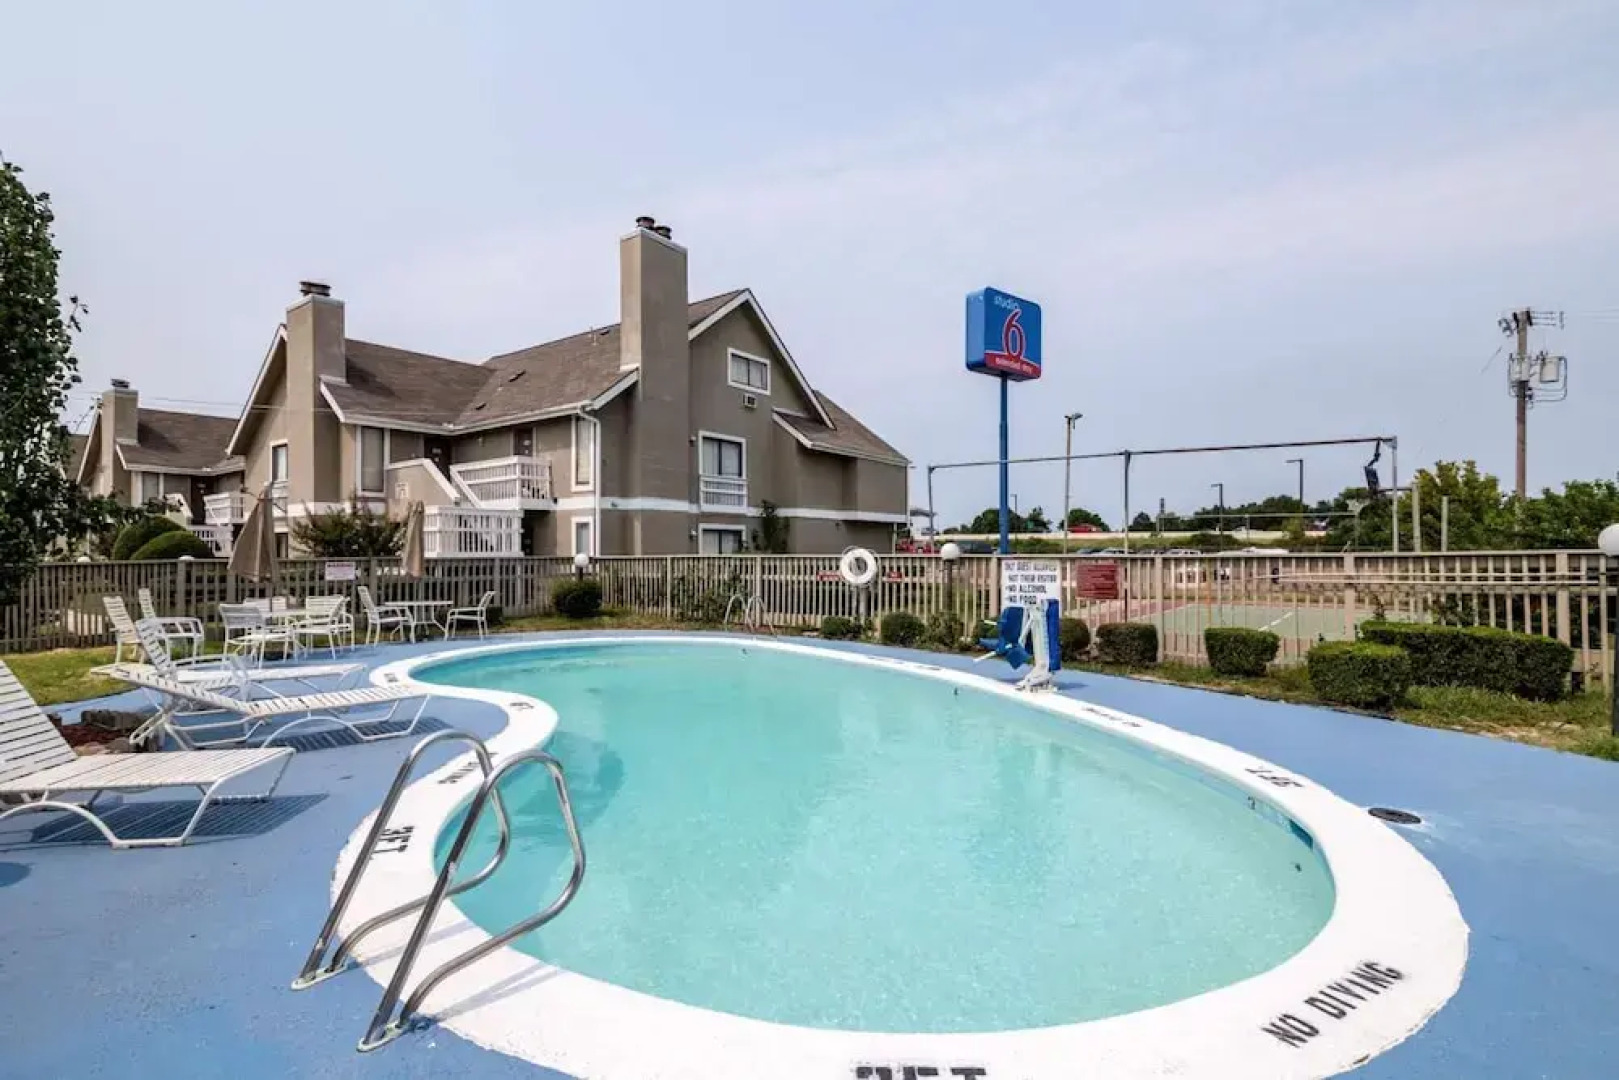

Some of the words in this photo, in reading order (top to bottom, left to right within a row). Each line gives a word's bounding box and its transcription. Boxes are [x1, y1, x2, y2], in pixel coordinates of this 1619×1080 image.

[1002, 309, 1026, 360] 6
[1261, 1013, 1320, 1049] NO
[1303, 961, 1405, 1020] DIVING
